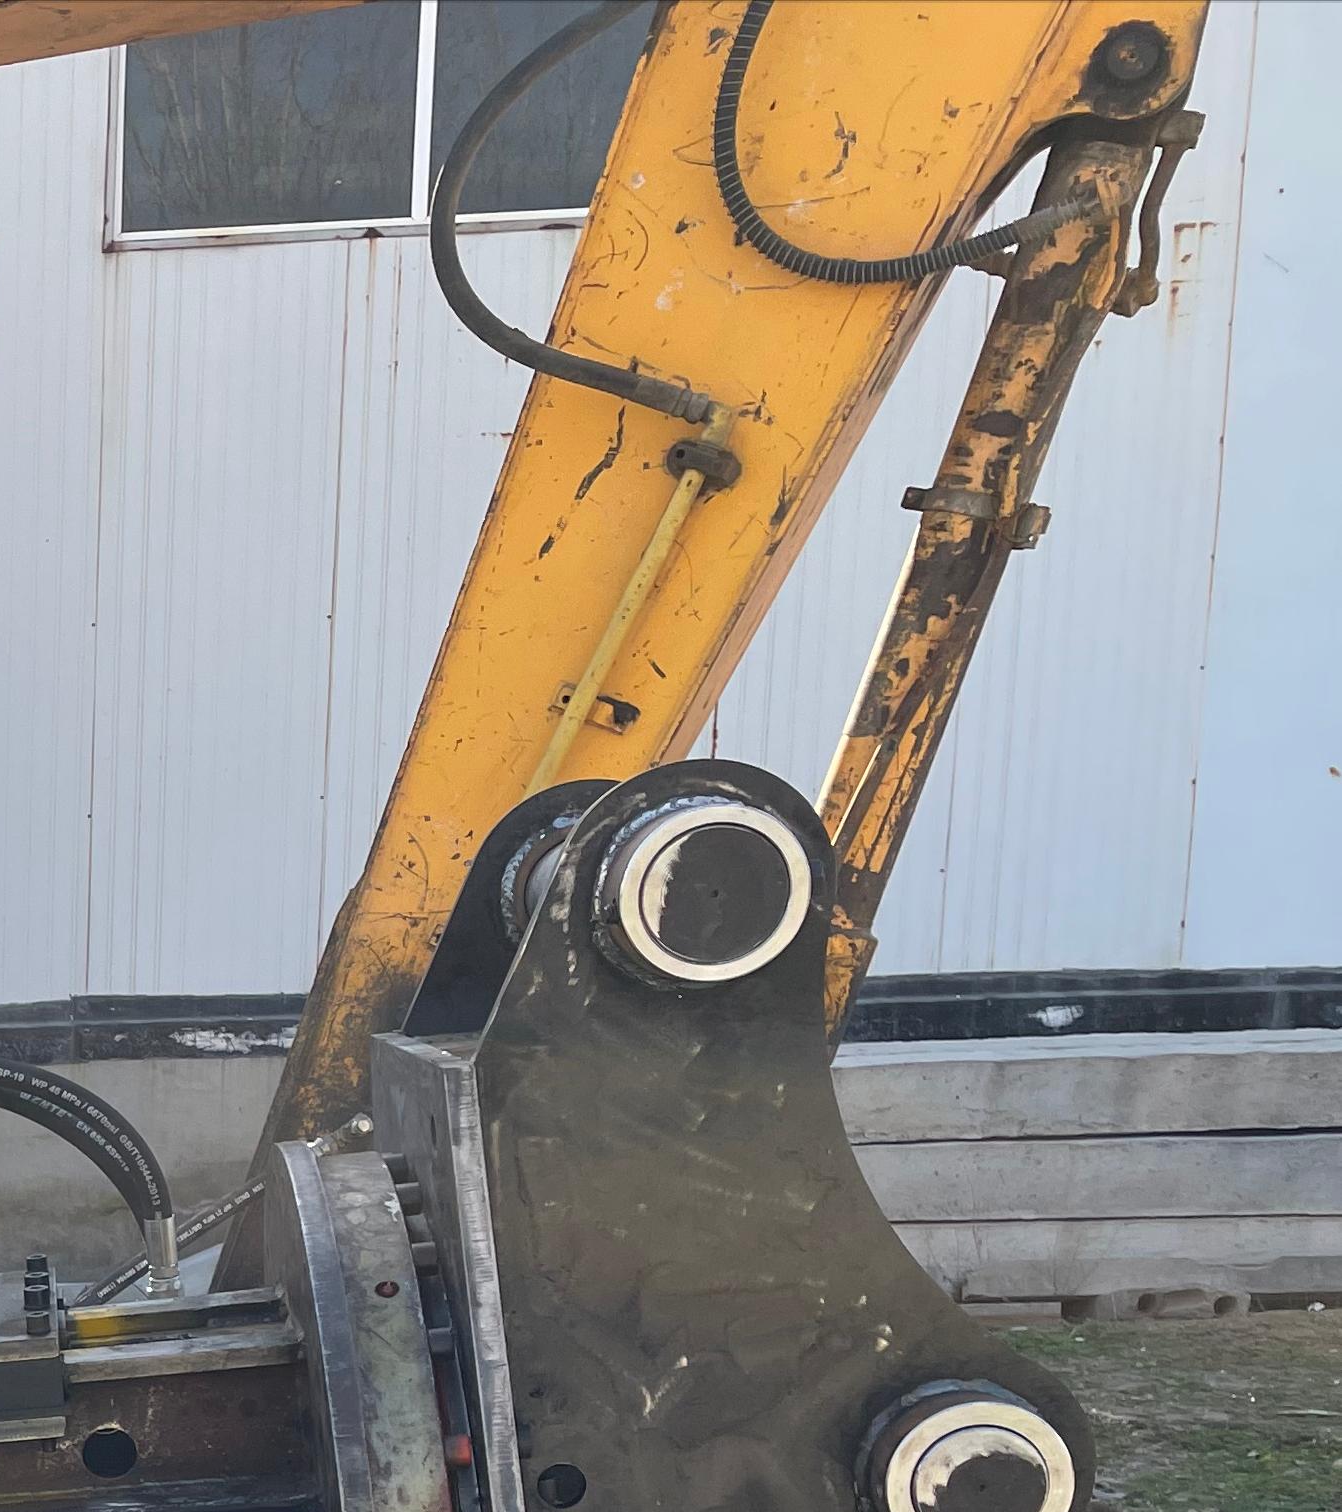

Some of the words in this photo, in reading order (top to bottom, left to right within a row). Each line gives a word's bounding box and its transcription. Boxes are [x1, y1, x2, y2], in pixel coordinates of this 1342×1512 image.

[31, 1077, 49, 1089] WP
[61, 1090, 81, 1106] MPa
[119, 1134, 161, 1206] GB/T10544-2013
